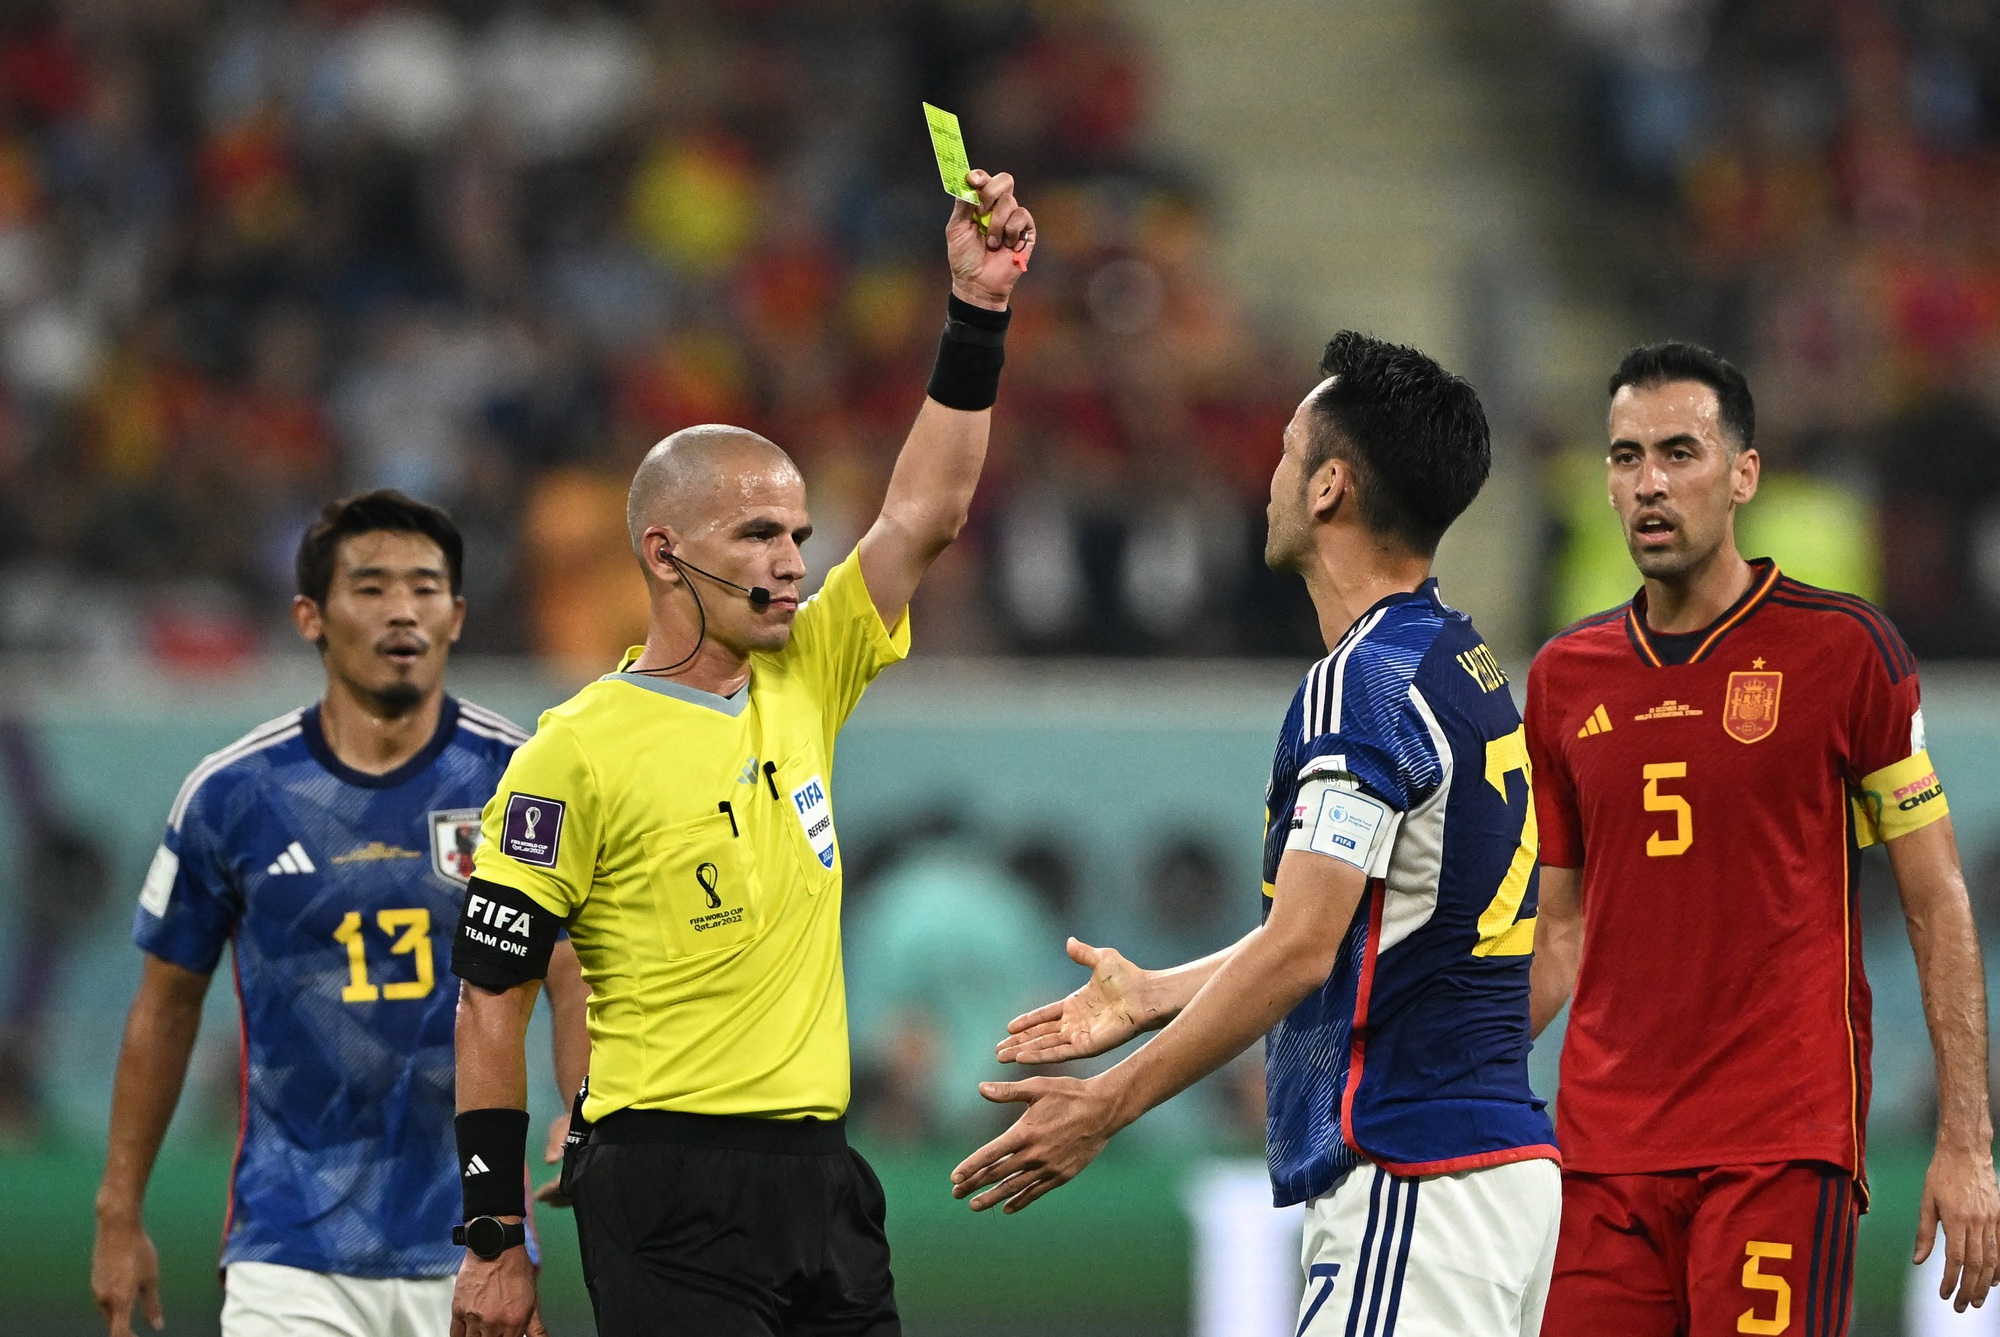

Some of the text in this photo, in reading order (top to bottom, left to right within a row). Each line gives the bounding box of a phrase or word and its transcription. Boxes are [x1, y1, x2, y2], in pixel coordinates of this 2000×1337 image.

[793, 781, 824, 815] FIFA
[1642, 761, 1694, 857] 5
[807, 815, 831, 839] REFEREE
[1335, 836, 1353, 848] FIFA
[821, 847, 833, 863] 2022
[467, 894, 530, 938] FIFA
[689, 907, 744, 925] FIFA WORLD CUP
[332, 907, 435, 1003] 13
[465, 925, 528, 957] TEAM ONE
[1737, 1240, 1793, 1336] 5
